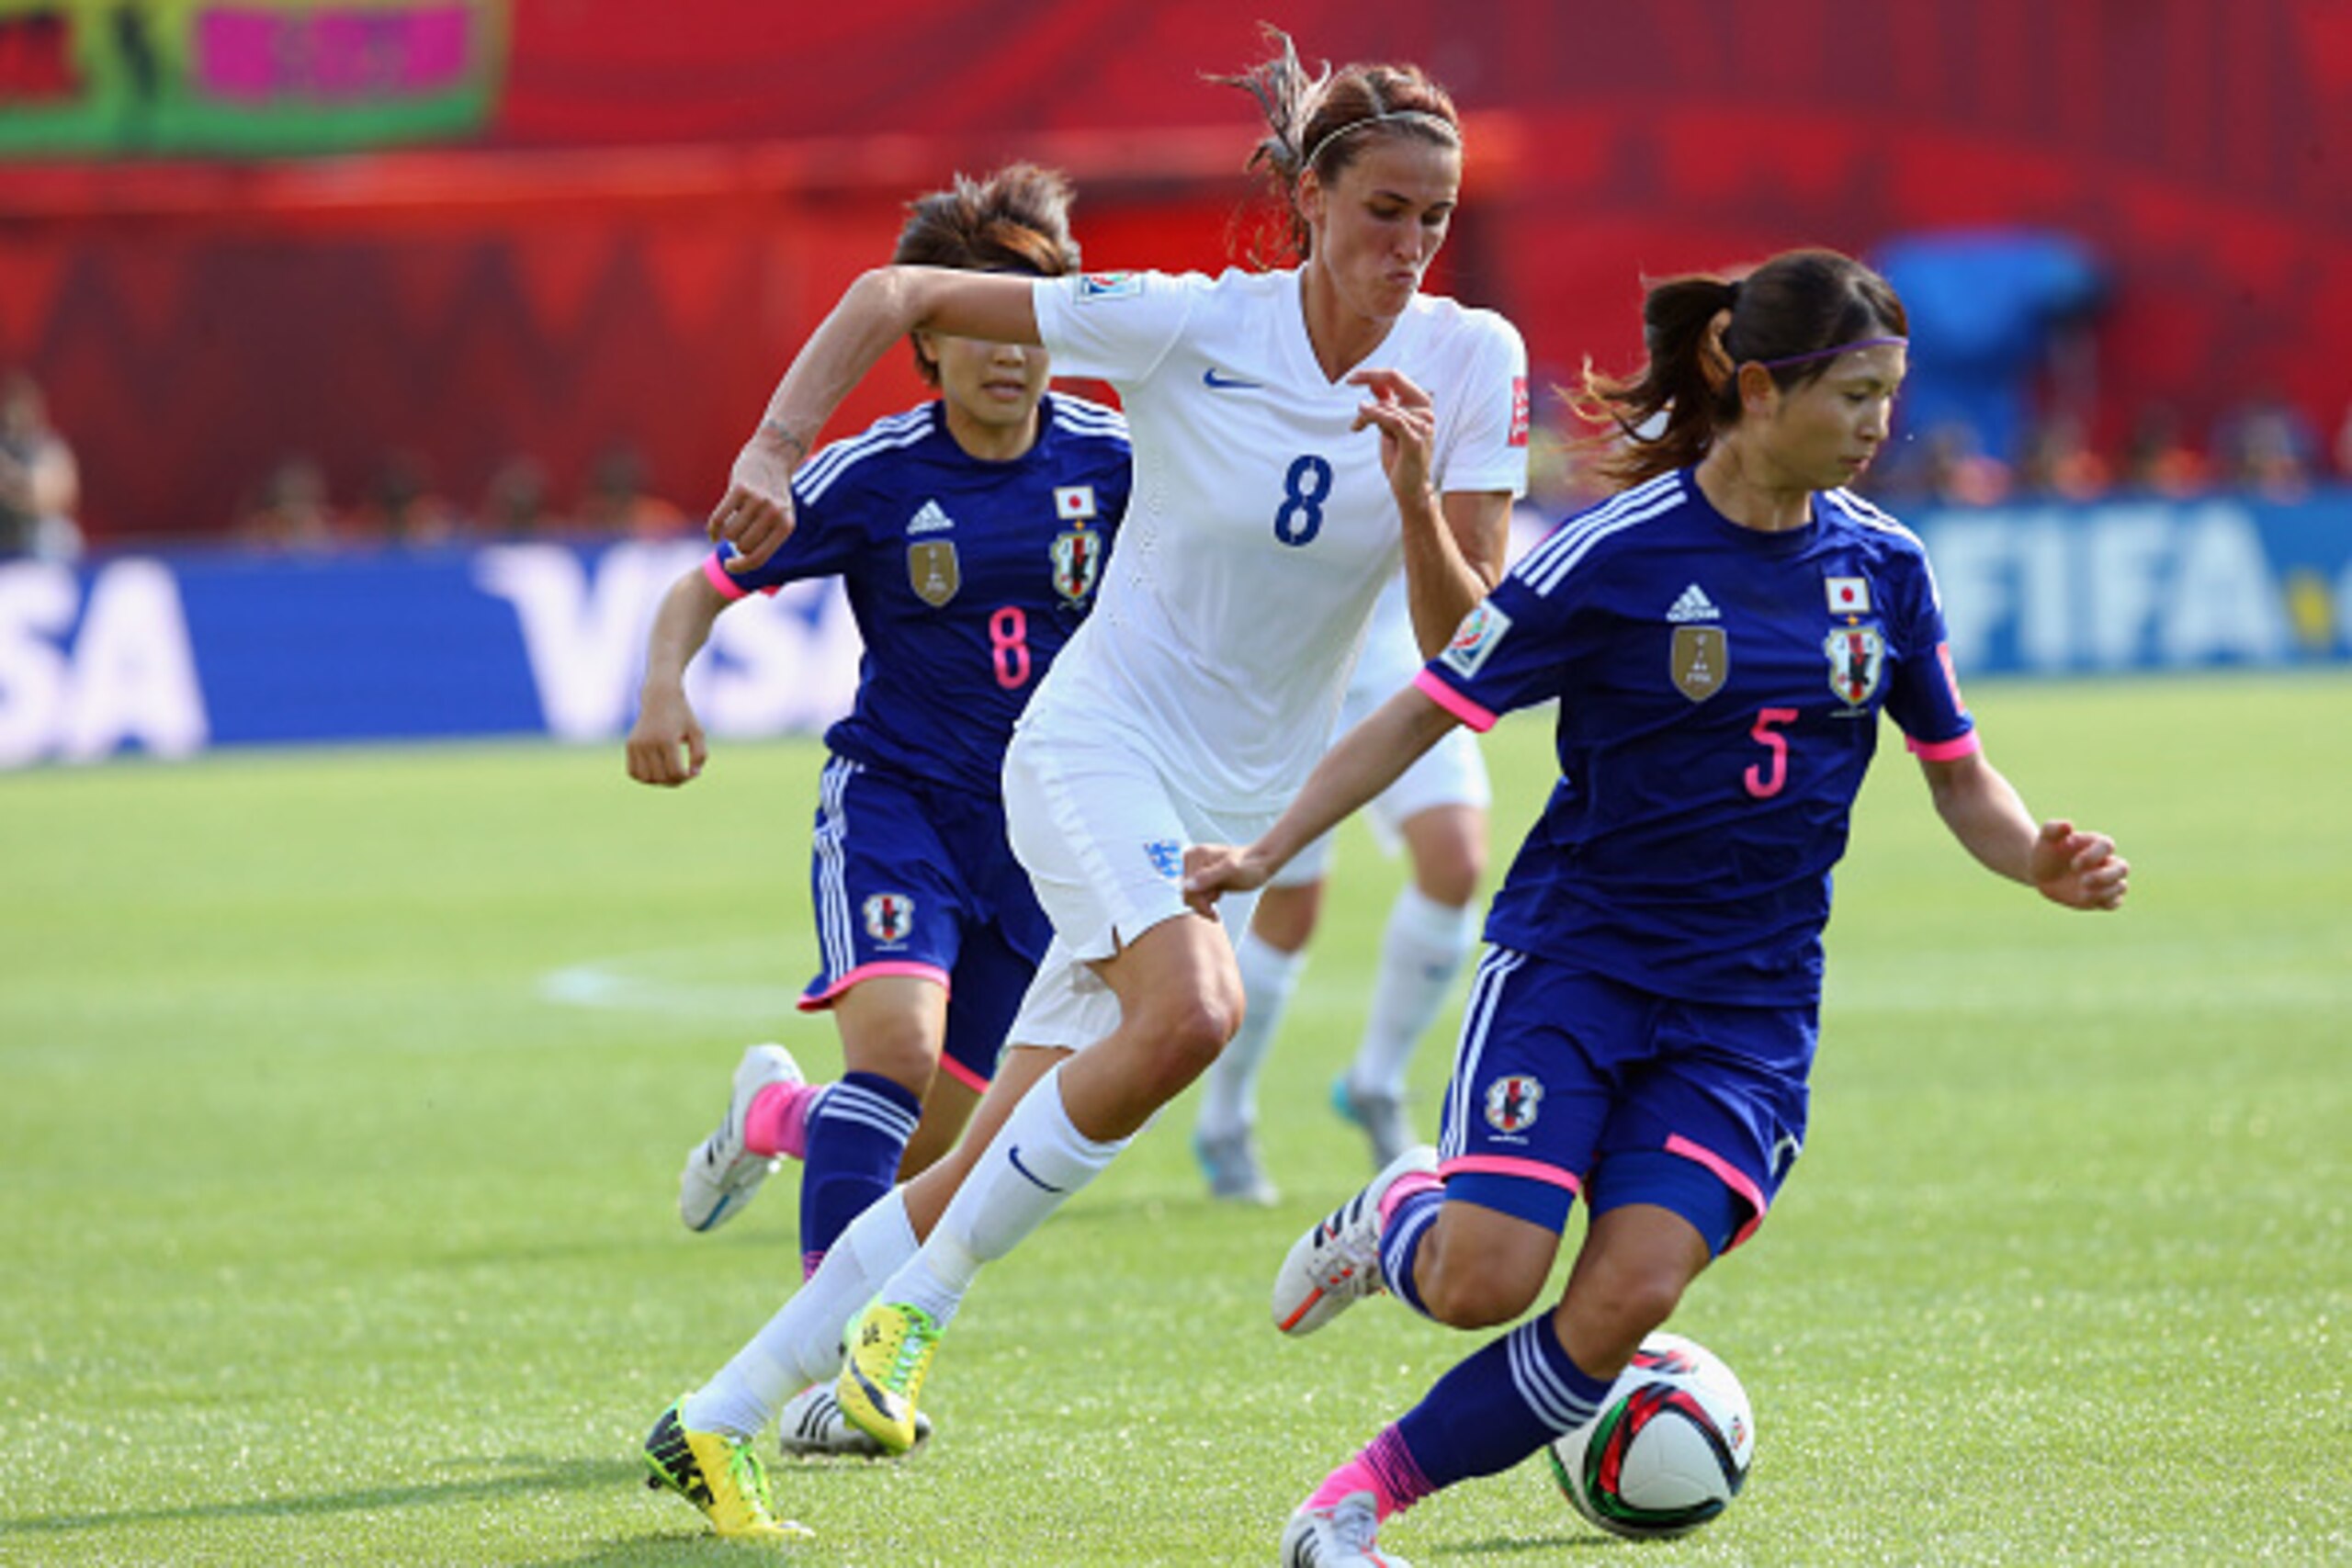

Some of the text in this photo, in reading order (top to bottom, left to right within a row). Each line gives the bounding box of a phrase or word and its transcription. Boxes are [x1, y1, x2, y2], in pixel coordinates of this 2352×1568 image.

[1275, 455, 1333, 546] 8
[989, 605, 1031, 689] 8
[1744, 707, 1799, 798] 5
